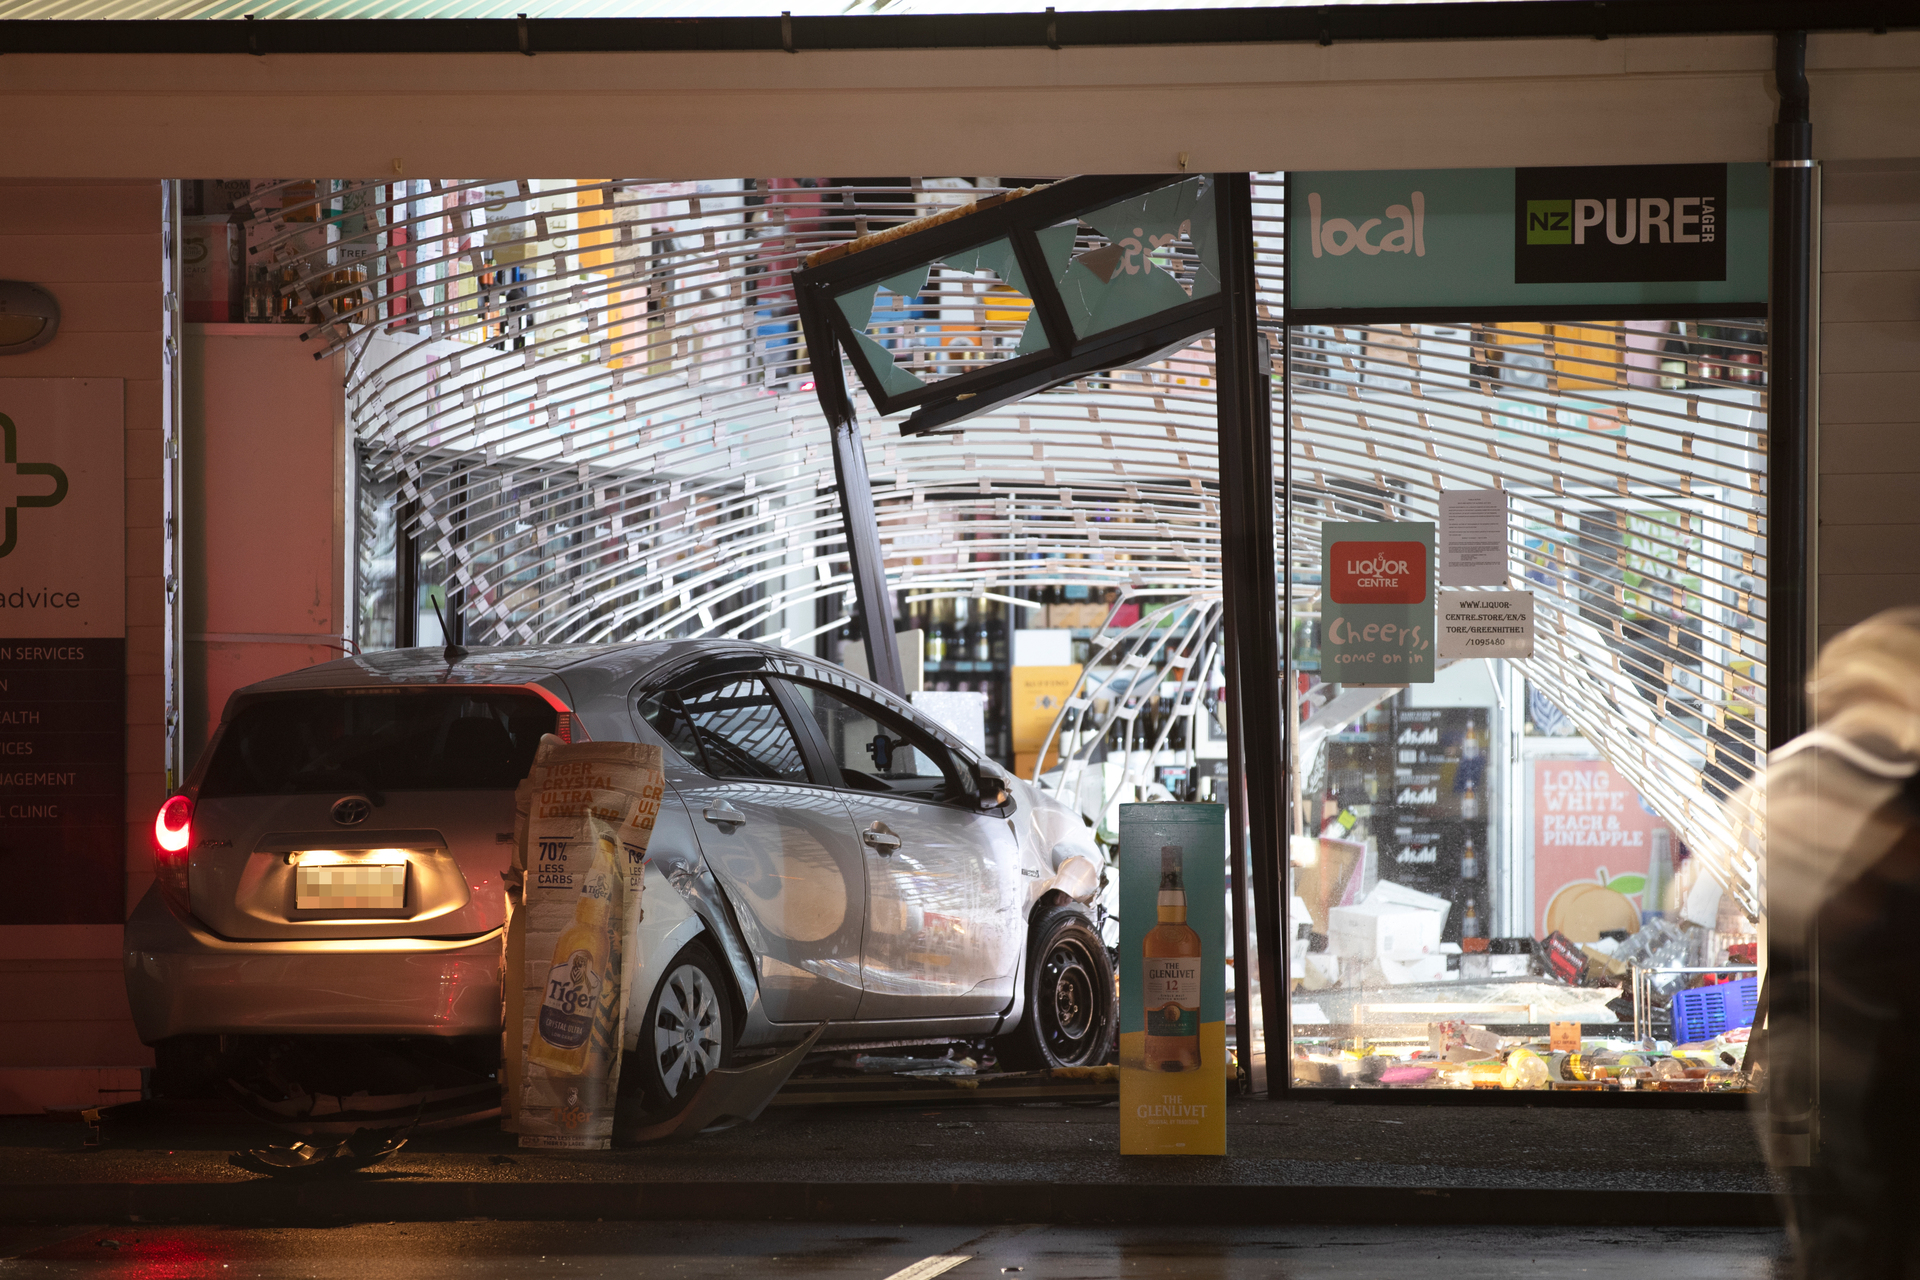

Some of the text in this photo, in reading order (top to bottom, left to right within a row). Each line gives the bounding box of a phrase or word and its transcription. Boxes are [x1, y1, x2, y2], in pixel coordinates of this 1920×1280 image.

[1308, 191, 1426, 258] local
[1529, 196, 1715, 245] NZ PURE LAGER
[1348, 557, 1410, 577] LIQUOR
[1357, 578, 1399, 588] CENTRE
[1460, 601, 1512, 609] WWW.LIQUOR-
[1328, 617, 1429, 650] Cheers,
[16, 647, 85, 660] SERVICES
[1334, 651, 1424, 664] come on in
[546, 763, 593, 777] TIGER
[542, 776, 615, 791] CRYSTAL
[1543, 770, 1610, 791] LONG
[541, 790, 594, 804] ULTRA
[1544, 791, 1625, 812] WHITE
[10, 805, 58, 818] CLINIC
[539, 805, 575, 819] LOW
[1543, 814, 1620, 831] PEACH &
[1543, 830, 1643, 847] PINEAPPLE
[539, 842, 567, 861] 70%
[538, 864, 564, 873] LESS
[538, 875, 573, 884] CARBS
[588, 885, 608, 899] Tiger
[1165, 962, 1180, 970] THE
[1149, 969, 1195, 979] GLENLIVET
[1166, 980, 1179, 991] 12
[548, 979, 597, 1014] Tiger
[546, 1018, 567, 1031] CRYSTAL
[1162, 1094, 1183, 1104] THE
[551, 1107, 594, 1129] Tiger
[1137, 1104, 1208, 1118] GLENLIVET
